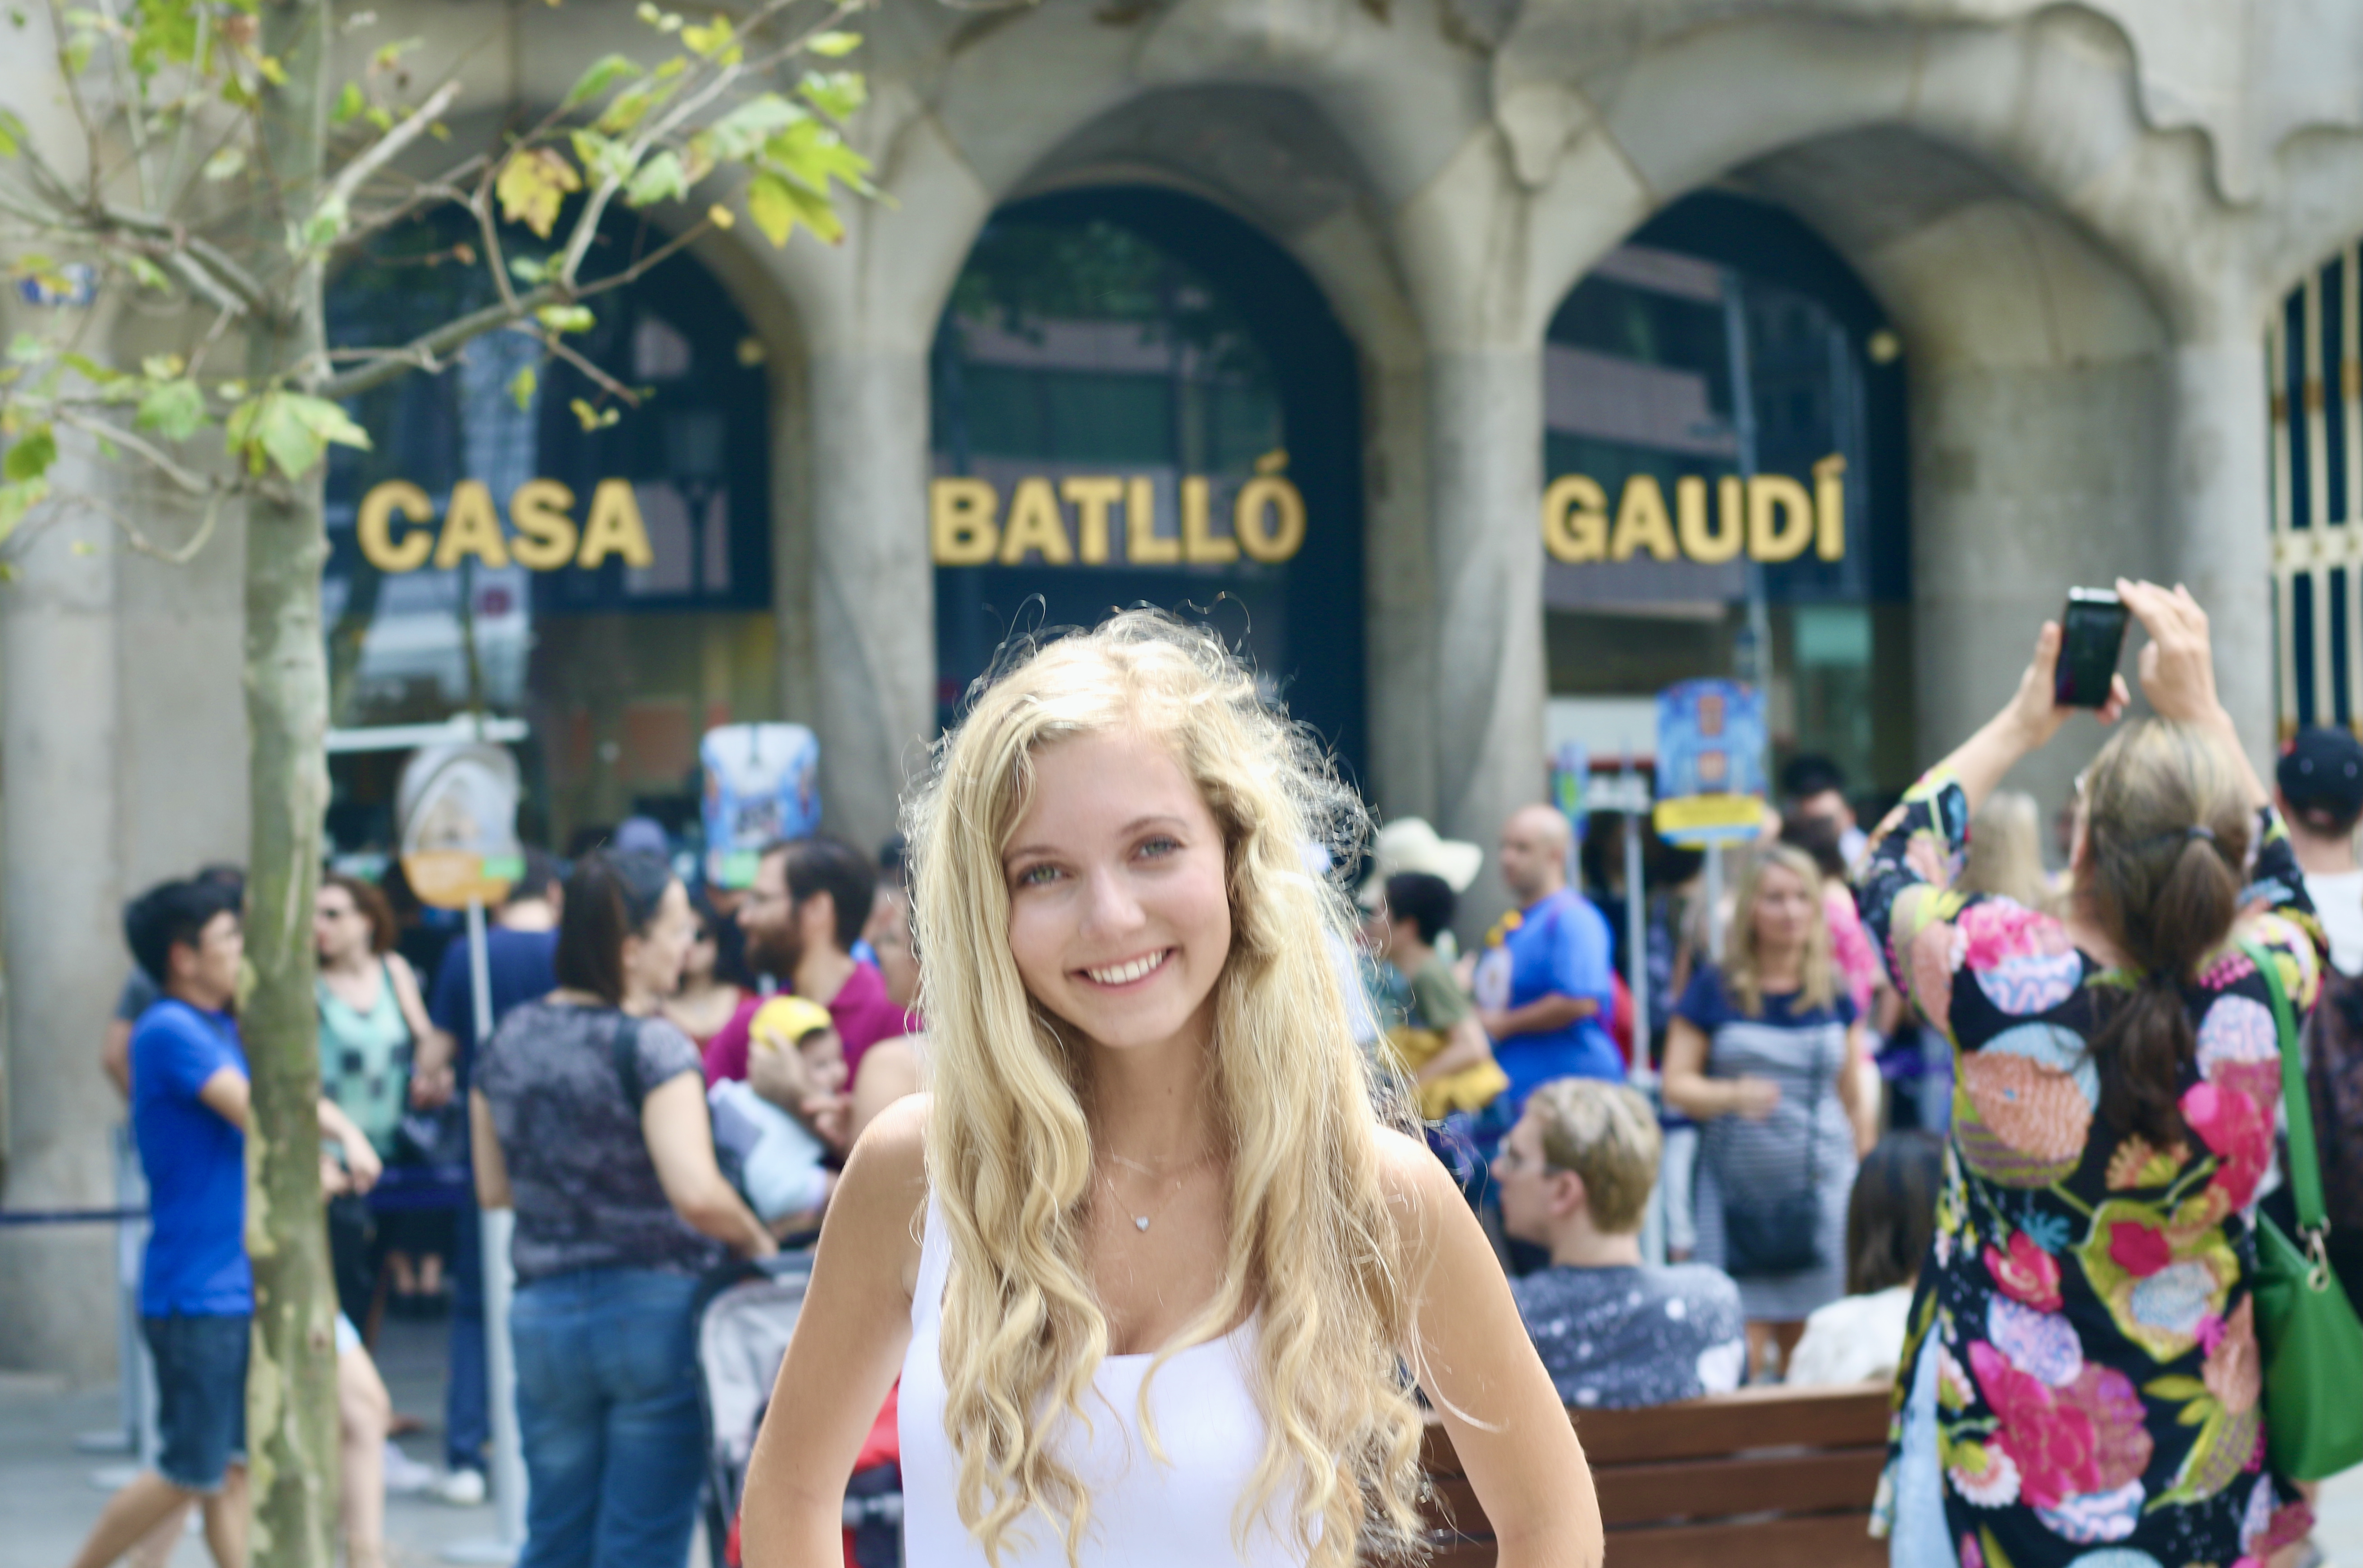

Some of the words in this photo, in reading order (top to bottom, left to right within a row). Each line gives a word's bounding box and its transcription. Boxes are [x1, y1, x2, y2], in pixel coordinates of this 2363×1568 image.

[358, 478, 654, 571] CASA
[928, 450, 1306, 566] BATLLÓ
[1541, 453, 1846, 564] GAUDÍ
